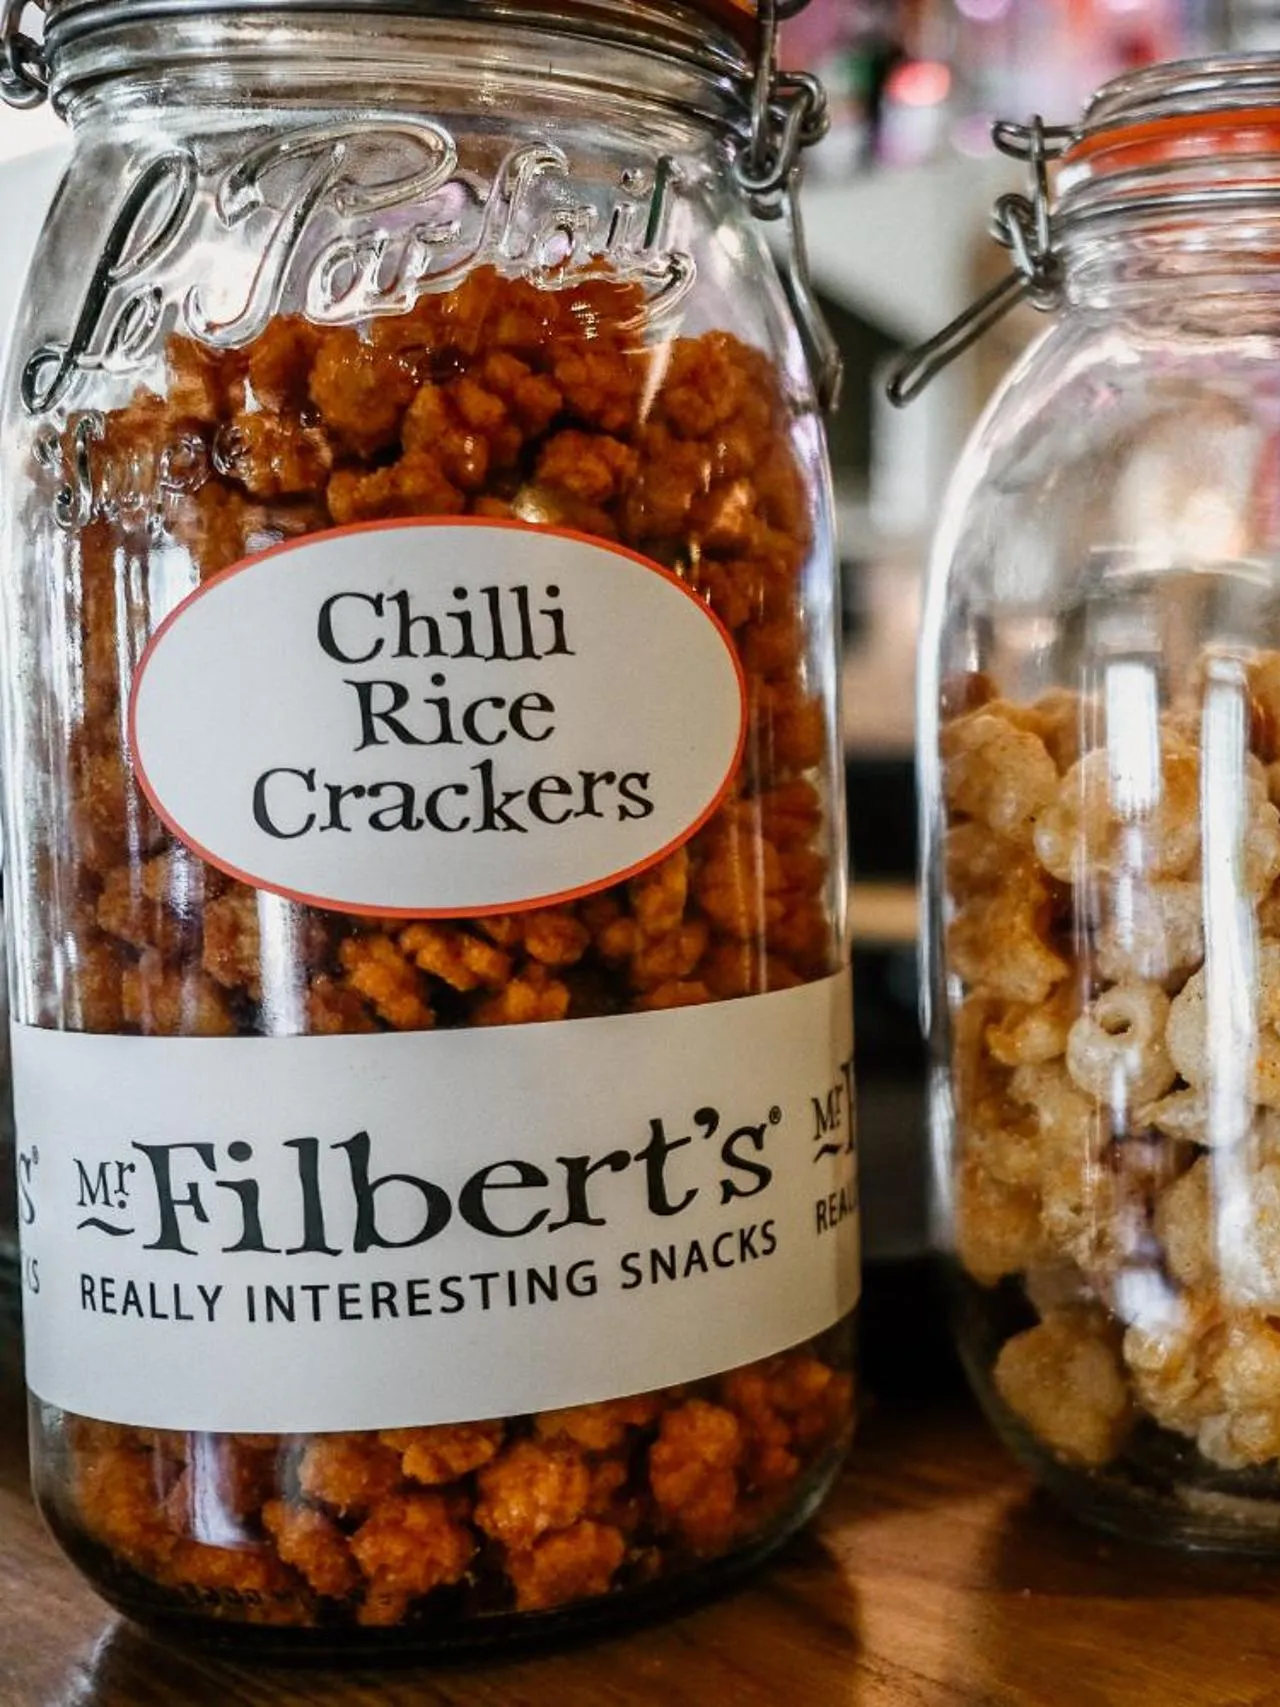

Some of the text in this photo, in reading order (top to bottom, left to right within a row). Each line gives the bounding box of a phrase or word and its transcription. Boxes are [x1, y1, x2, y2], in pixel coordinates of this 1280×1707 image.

[317, 584, 577, 665] Chilli
[343, 672, 556, 752] Rice
[252, 758, 655, 839] Crackers
[80, 1273, 223, 1322] REALLY
[246, 1259, 598, 1323] INTERESTING
[620, 1218, 778, 1291] SNACKS
